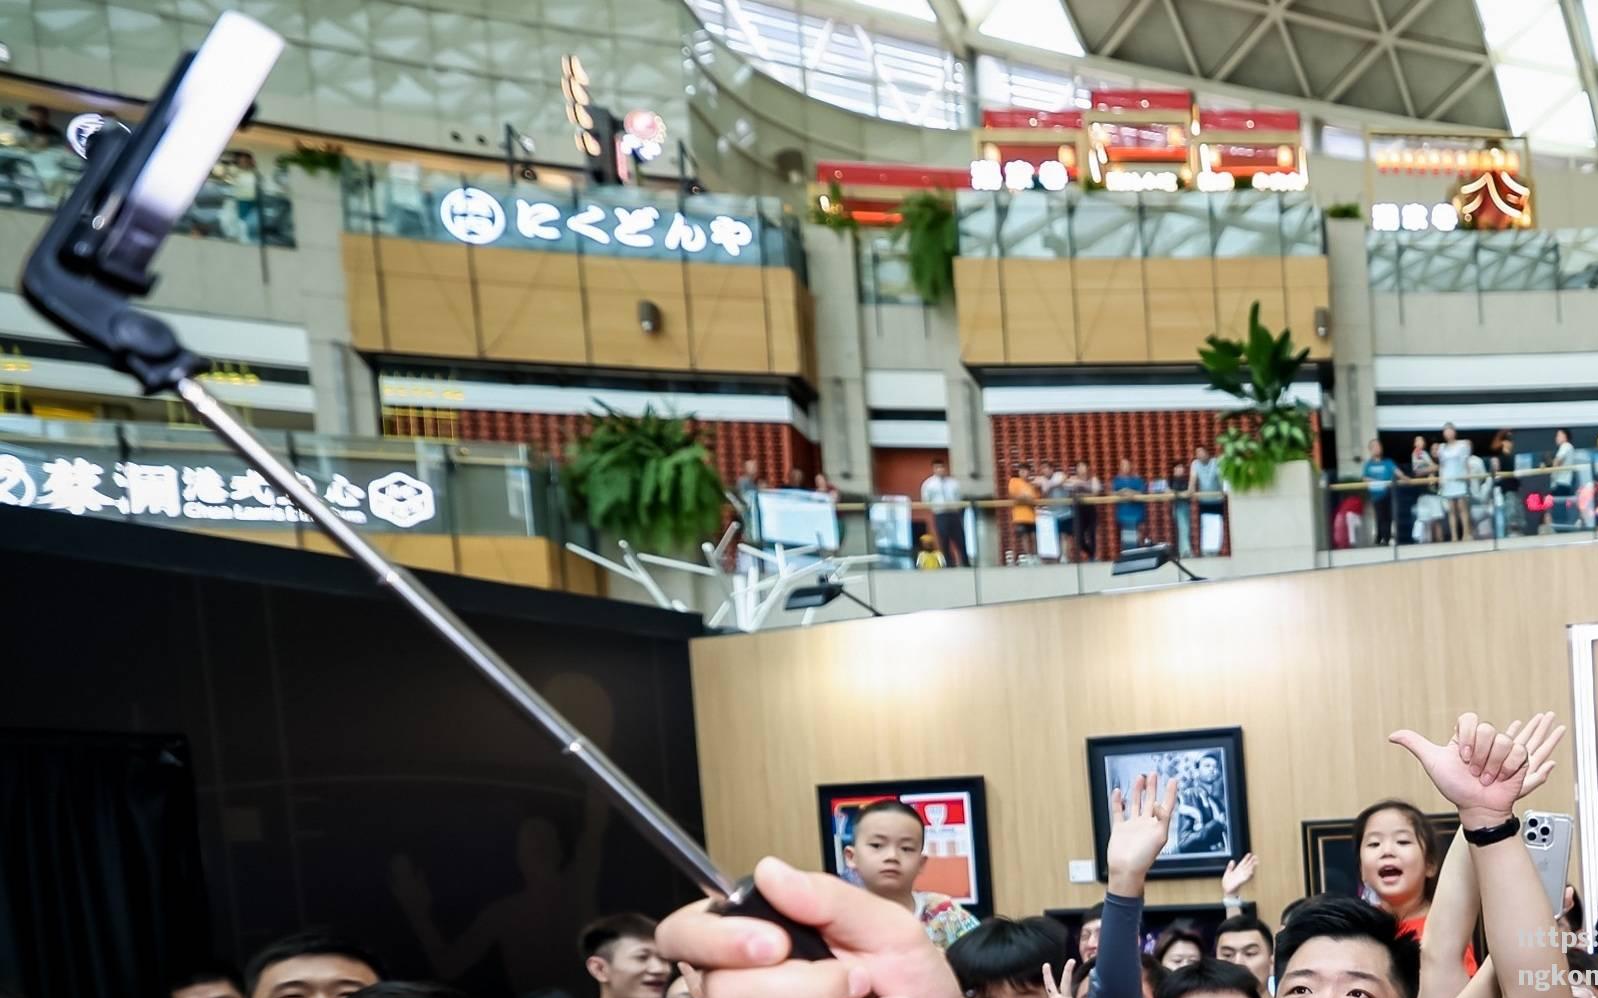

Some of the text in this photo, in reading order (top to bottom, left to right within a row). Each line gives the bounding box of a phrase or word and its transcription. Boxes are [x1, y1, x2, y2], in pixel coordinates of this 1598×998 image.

[516, 198, 753, 257] にくどんや
